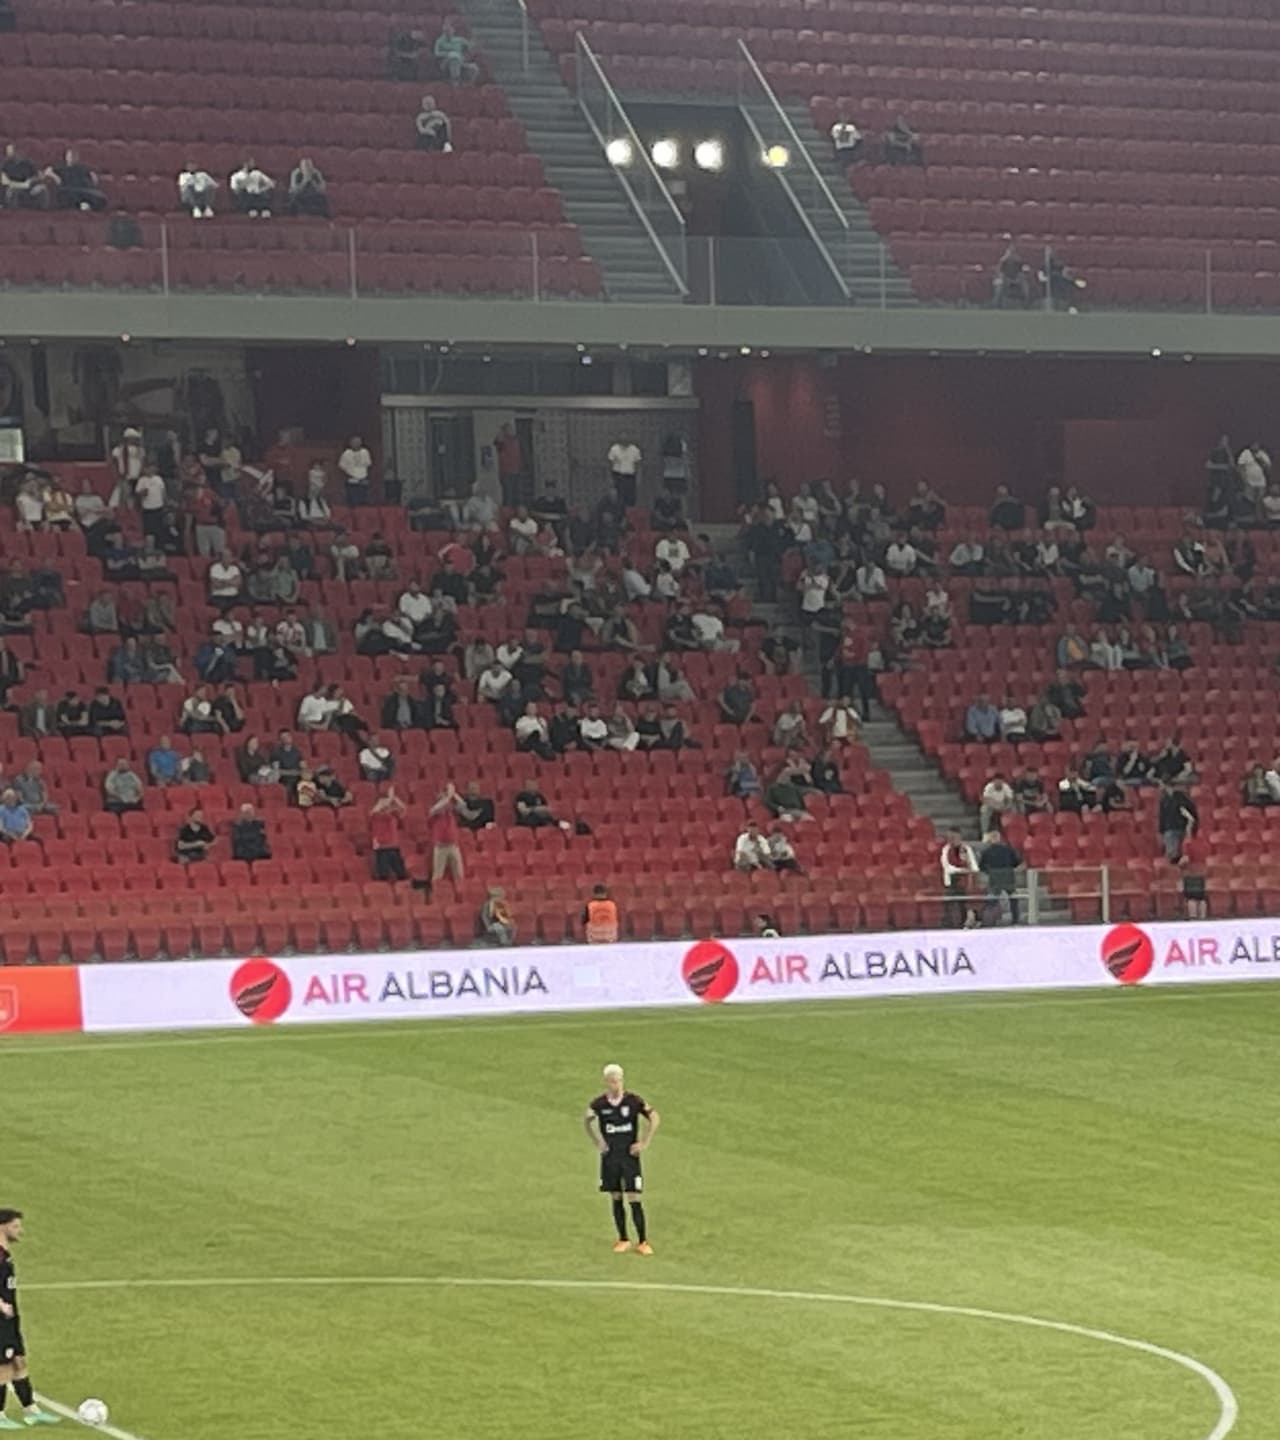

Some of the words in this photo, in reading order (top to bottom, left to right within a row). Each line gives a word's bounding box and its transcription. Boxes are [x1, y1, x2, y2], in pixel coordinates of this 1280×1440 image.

[749, 954, 811, 985] AIR
[819, 947, 976, 981] ALBANIA
[1164, 938, 1222, 967] AIR
[303, 973, 370, 1005] AIR
[379, 966, 548, 1000] ALBANIA
